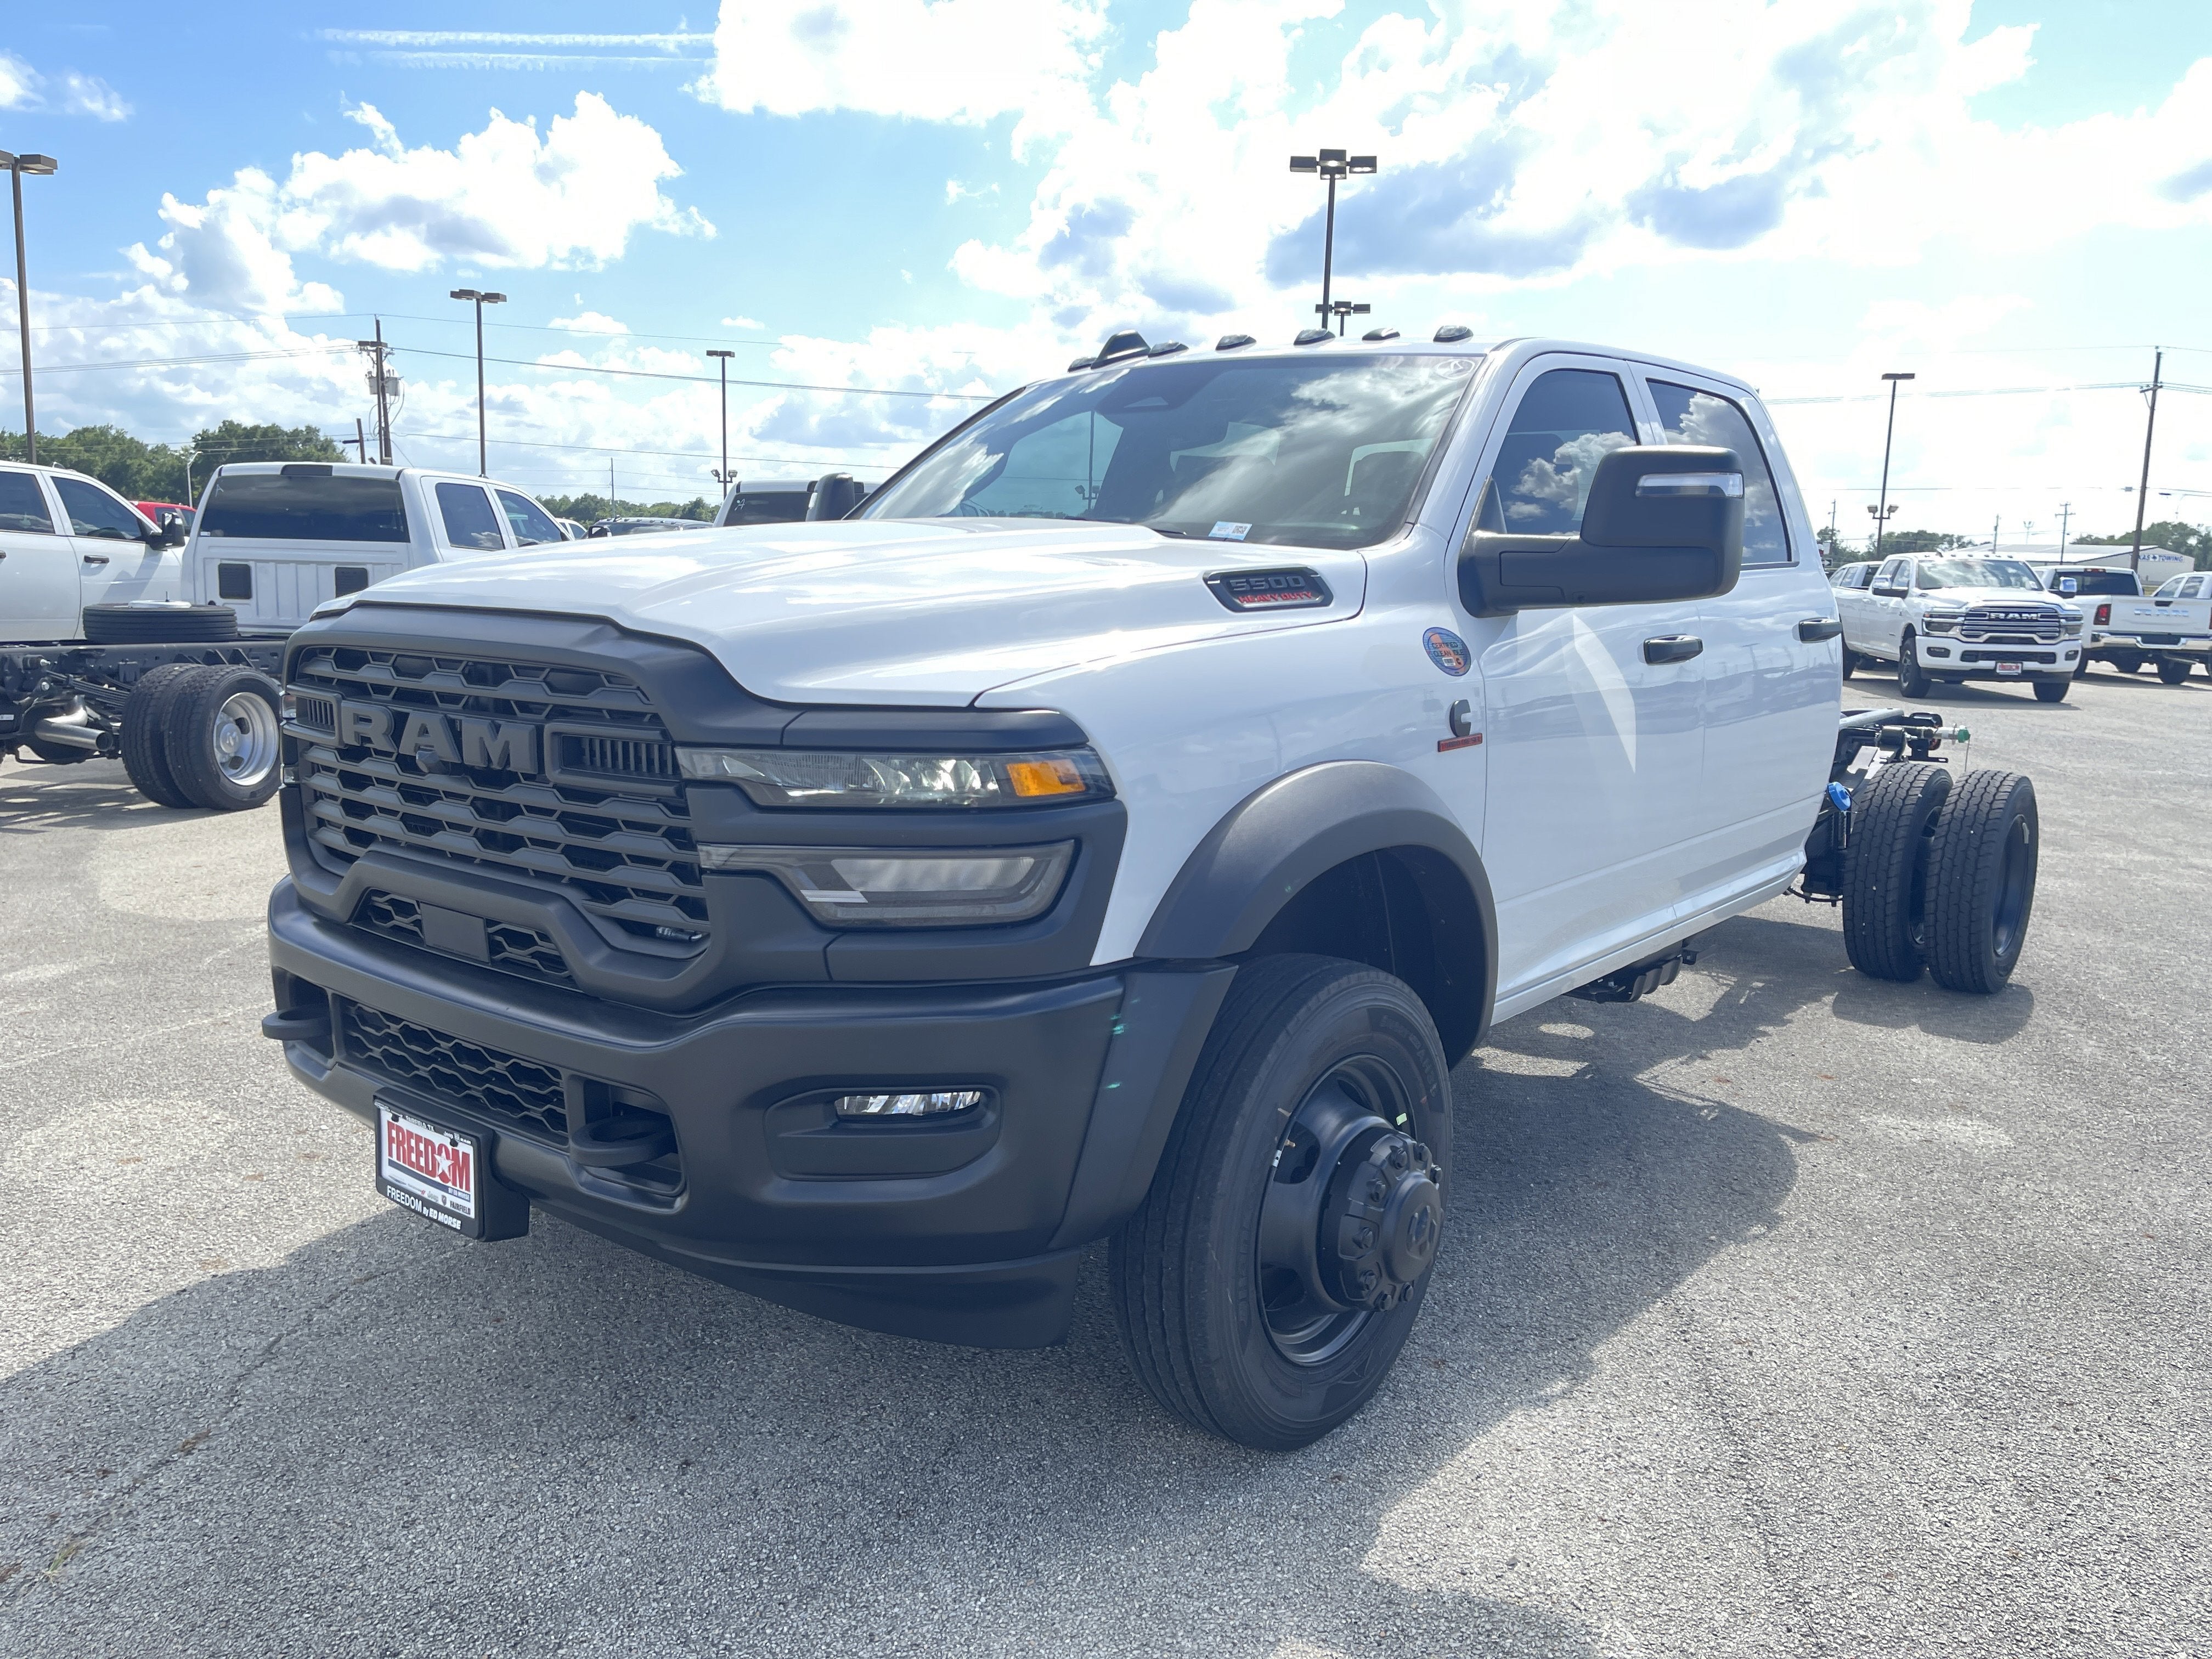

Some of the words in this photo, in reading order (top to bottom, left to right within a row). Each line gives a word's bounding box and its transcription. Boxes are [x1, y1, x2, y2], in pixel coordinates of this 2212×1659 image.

[1229, 575, 1306, 591] 5500
[1238, 594, 1279, 603] HEAVY
[1280, 591, 1313, 601] DUTY
[2134, 608, 2189, 617] RAM
[340, 699, 538, 775] RAM
[387, 1120, 471, 1192] FREEDOM
[387, 1185, 422, 1212] FREEDOM
[423, 1206, 429, 1217] by
[428, 1207, 438, 1220] ED
[438, 1211, 462, 1230] MORSE
[450, 1200, 471, 1215] FAIRFIELD
